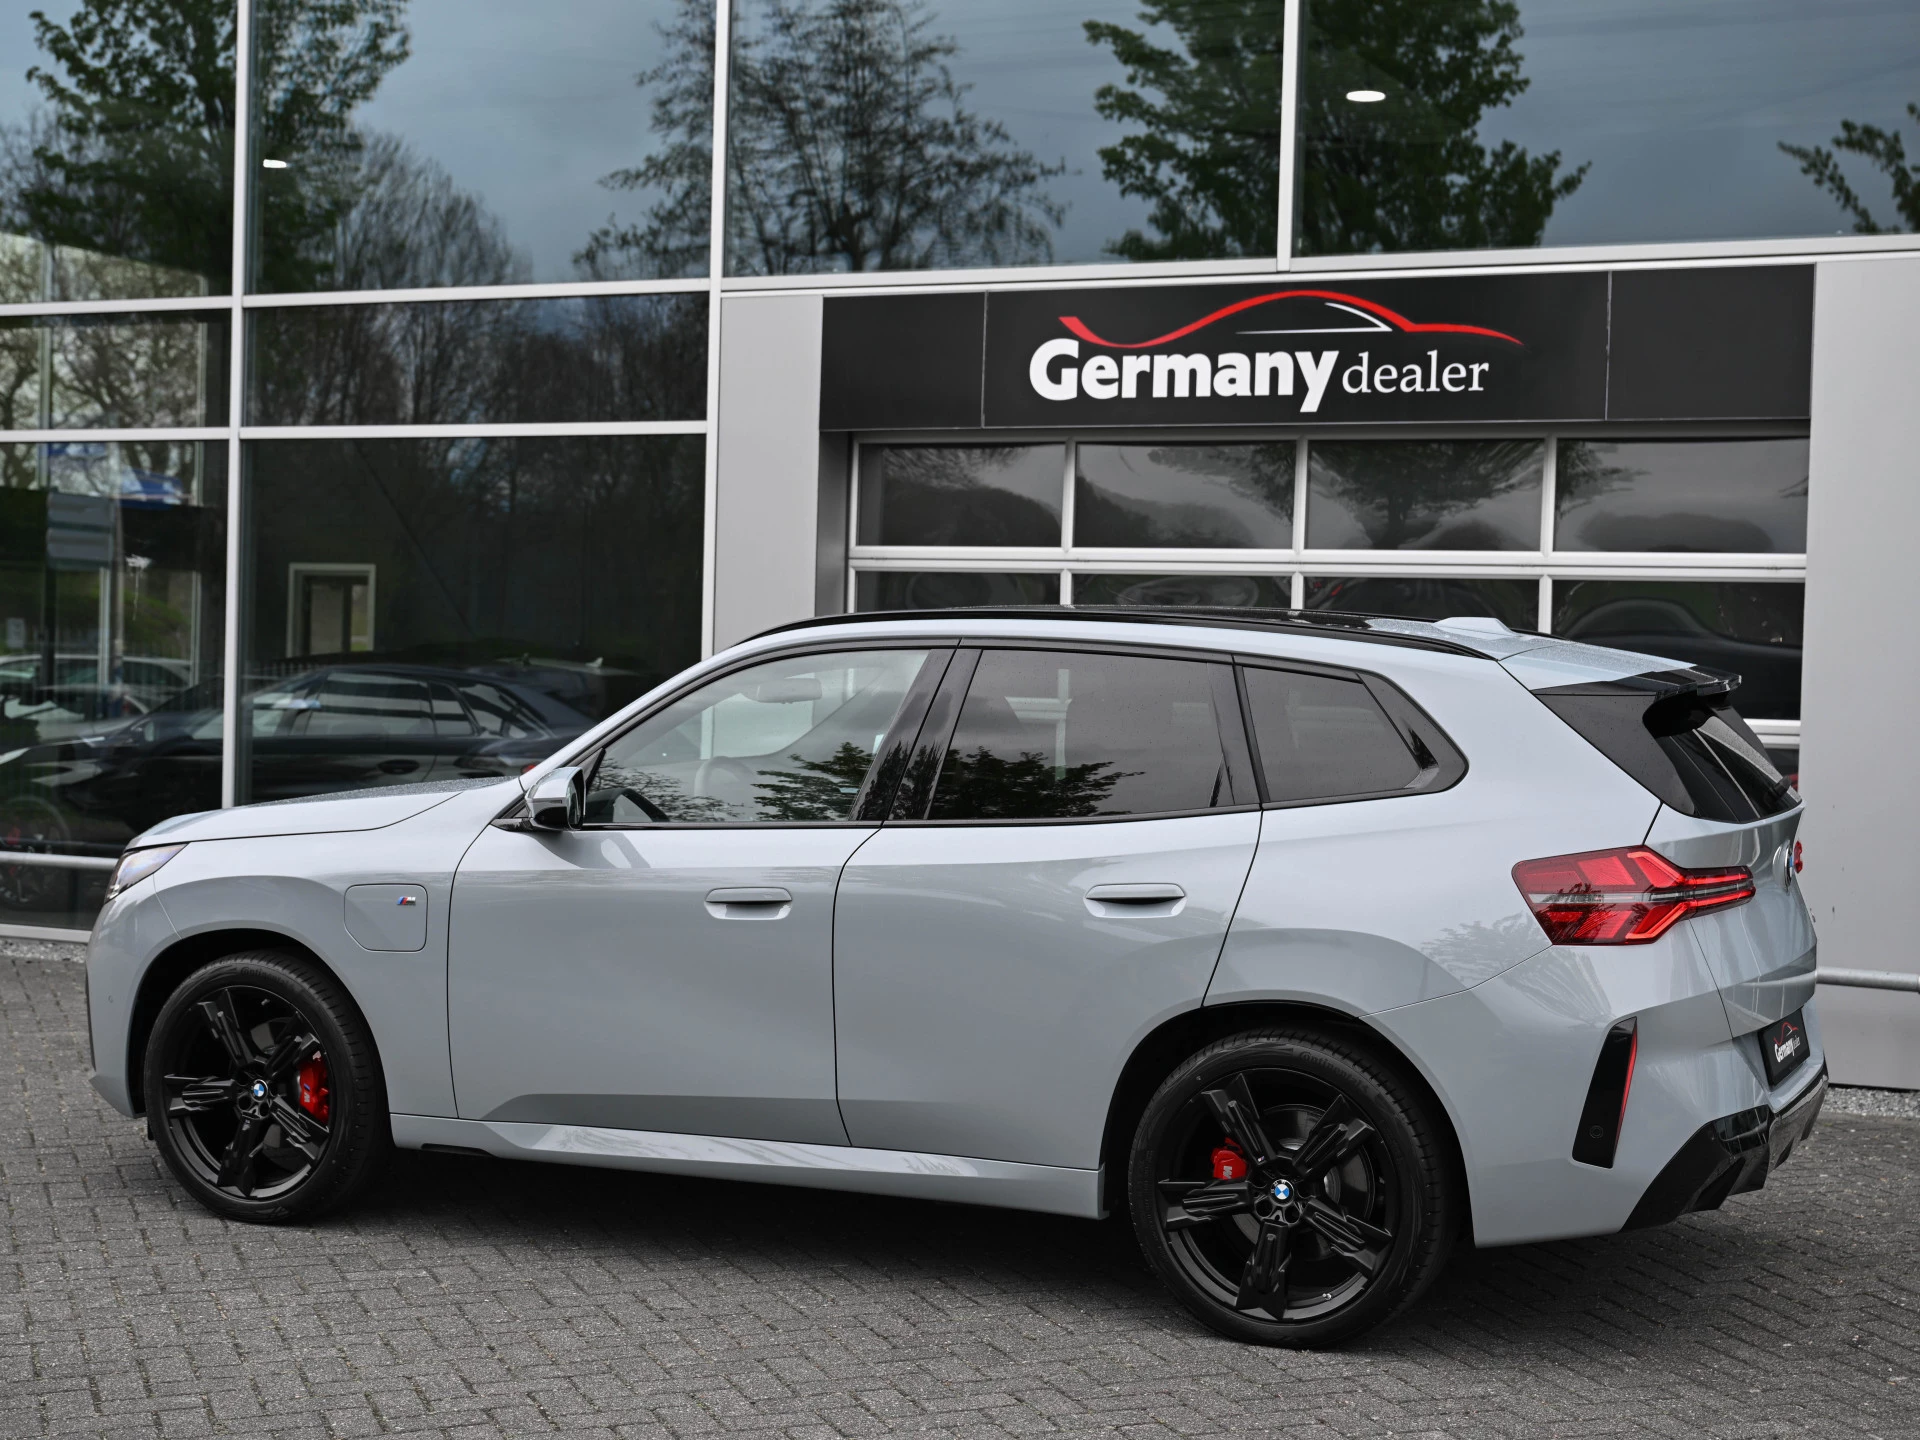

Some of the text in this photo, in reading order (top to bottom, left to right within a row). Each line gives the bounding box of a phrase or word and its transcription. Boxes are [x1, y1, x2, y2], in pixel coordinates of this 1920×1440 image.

[1029, 337, 1490, 413] Germany dealer
[1774, 1037, 1795, 1063] Germany
